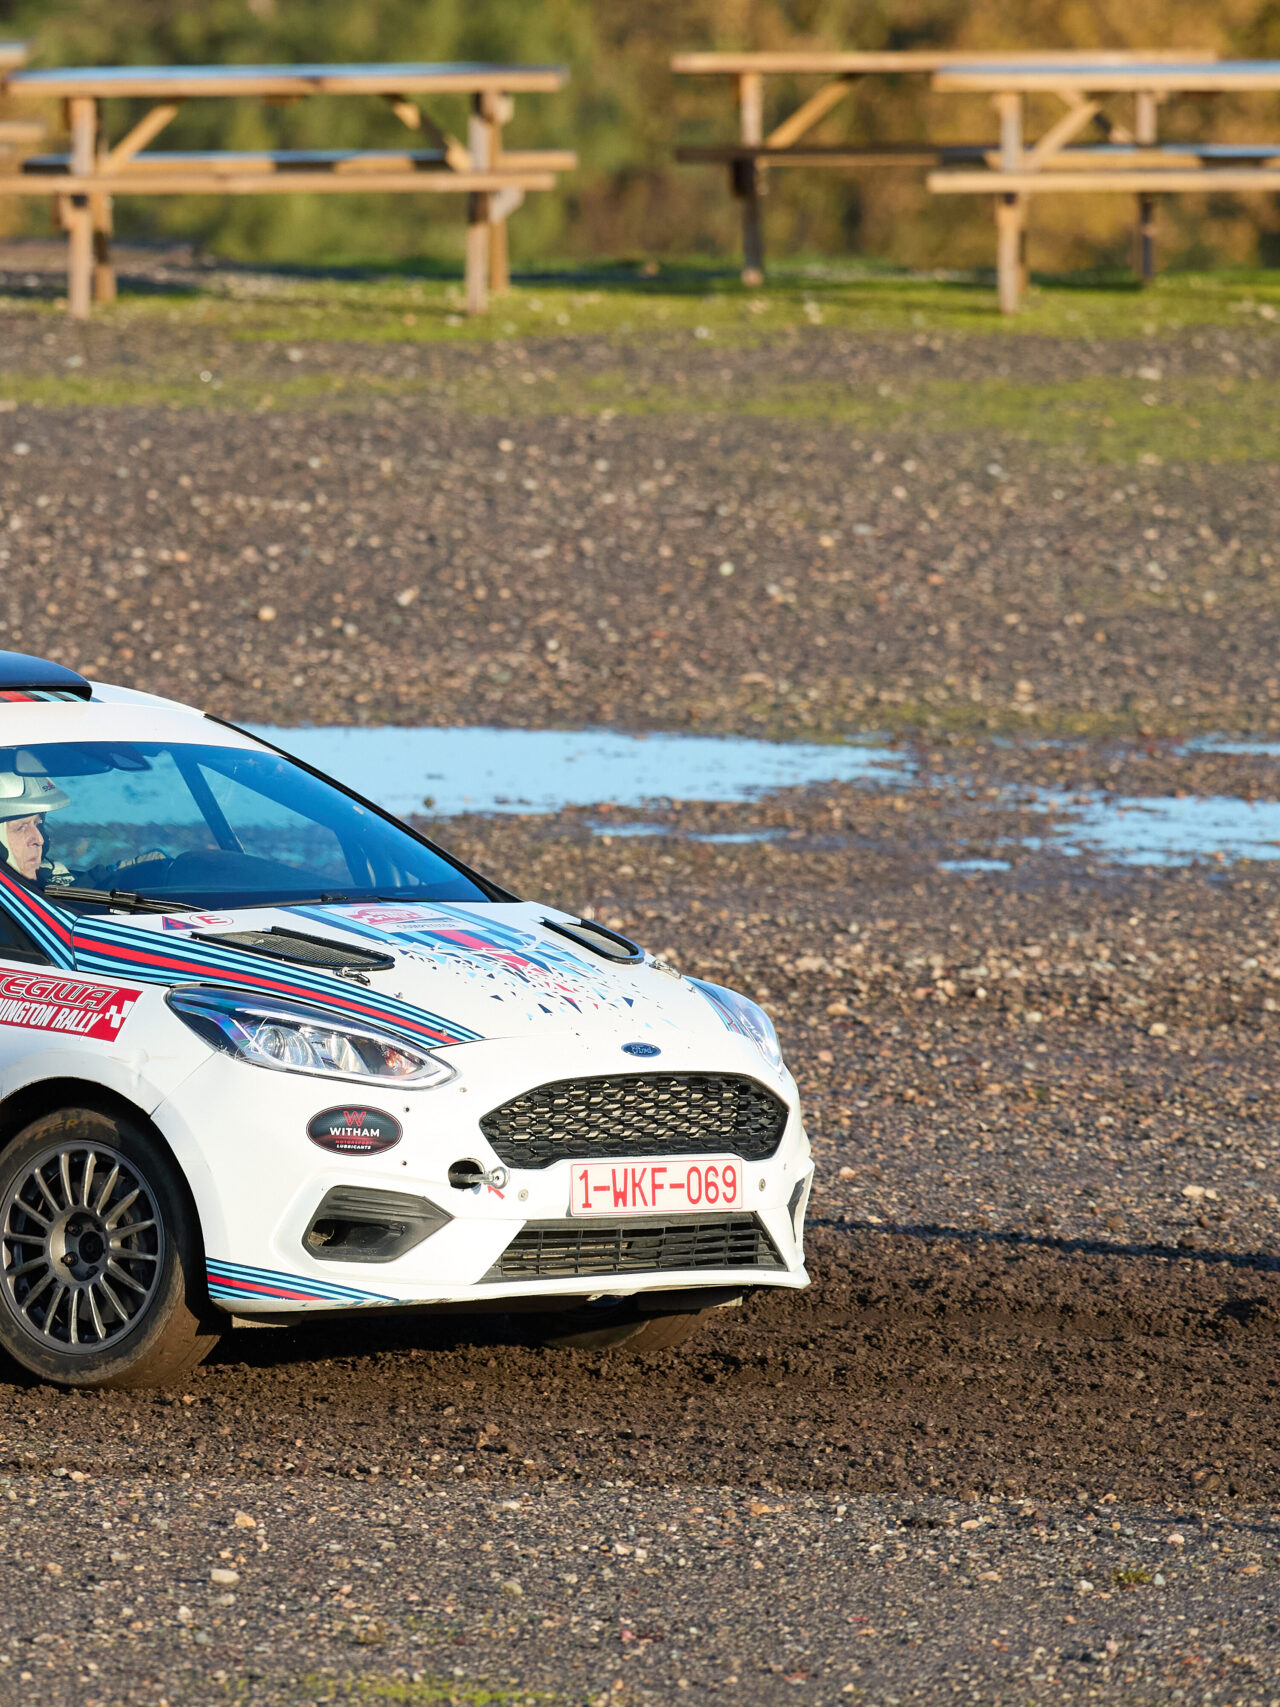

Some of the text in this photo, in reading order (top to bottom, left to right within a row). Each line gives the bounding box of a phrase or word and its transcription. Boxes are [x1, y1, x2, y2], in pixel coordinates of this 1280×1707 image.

[50, 1007, 103, 1033] RALLY
[329, 1127, 380, 1137] WITHAM
[579, 1164, 737, 1209] 1-WKF-069
